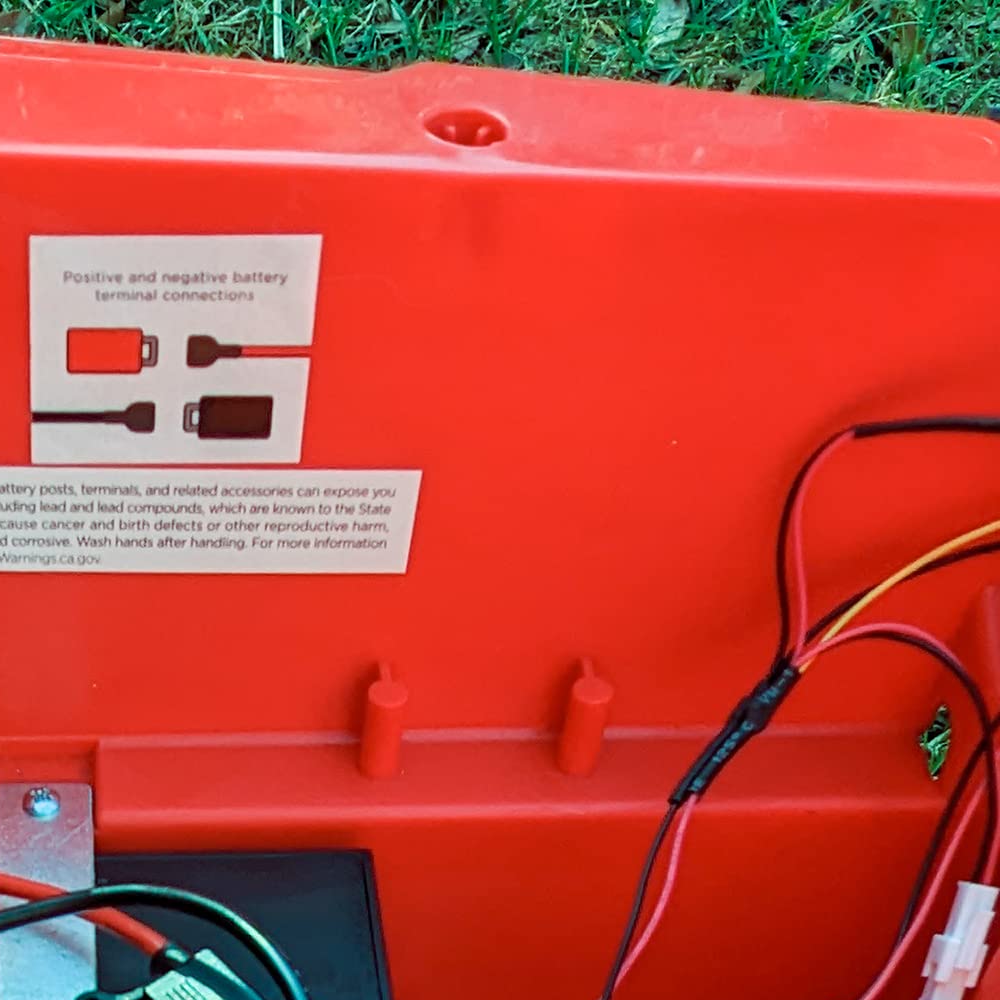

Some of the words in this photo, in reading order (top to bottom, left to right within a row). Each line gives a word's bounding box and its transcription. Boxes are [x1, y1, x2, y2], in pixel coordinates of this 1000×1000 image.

[63, 270, 123, 284] Positive
[128, 270, 157, 284] and
[161, 271, 227, 287] negative
[232, 270, 289, 287] battery
[95, 289, 158, 302] terminal
[162, 290, 255, 303] connections
[39, 485, 78, 499] posts,
[81, 484, 142, 498] terminals,
[145, 485, 170, 497] and
[173, 485, 218, 497] related
[220, 486, 294, 498] accessories
[296, 487, 320, 498] can
[323, 488, 370, 501] expose
[371, 489, 397, 500] you
[40, 501, 67, 513] lead
[70, 501, 95, 513] and
[98, 502, 124, 514] lead
[127, 502, 205, 517] compounds,
[209, 502, 247, 515] which
[249, 505, 270, 515] are
[272, 503, 316, 515] known
[318, 504, 332, 515] to
[335, 503, 356, 515] the
[358, 503, 392, 516] State
[0, 520, 38, 530] cause
[41, 521, 86, 531] cancer
[89, 518, 115, 531] and
[118, 519, 151, 532] birth
[153, 520, 202, 533] defects
[206, 523, 221, 533] or
[224, 520, 261, 533] other
[263, 521, 349, 534] reproductive
[352, 521, 390, 535] harm,
[11, 536, 73, 548] corrosive.
[76, 536, 112, 548] Wash
[114, 537, 154, 549] hands
[157, 537, 186, 549] after
[190, 537, 248, 551] handling.
[251, 537, 273, 550] For
[276, 539, 311, 550] more
[314, 537, 388, 550] information
